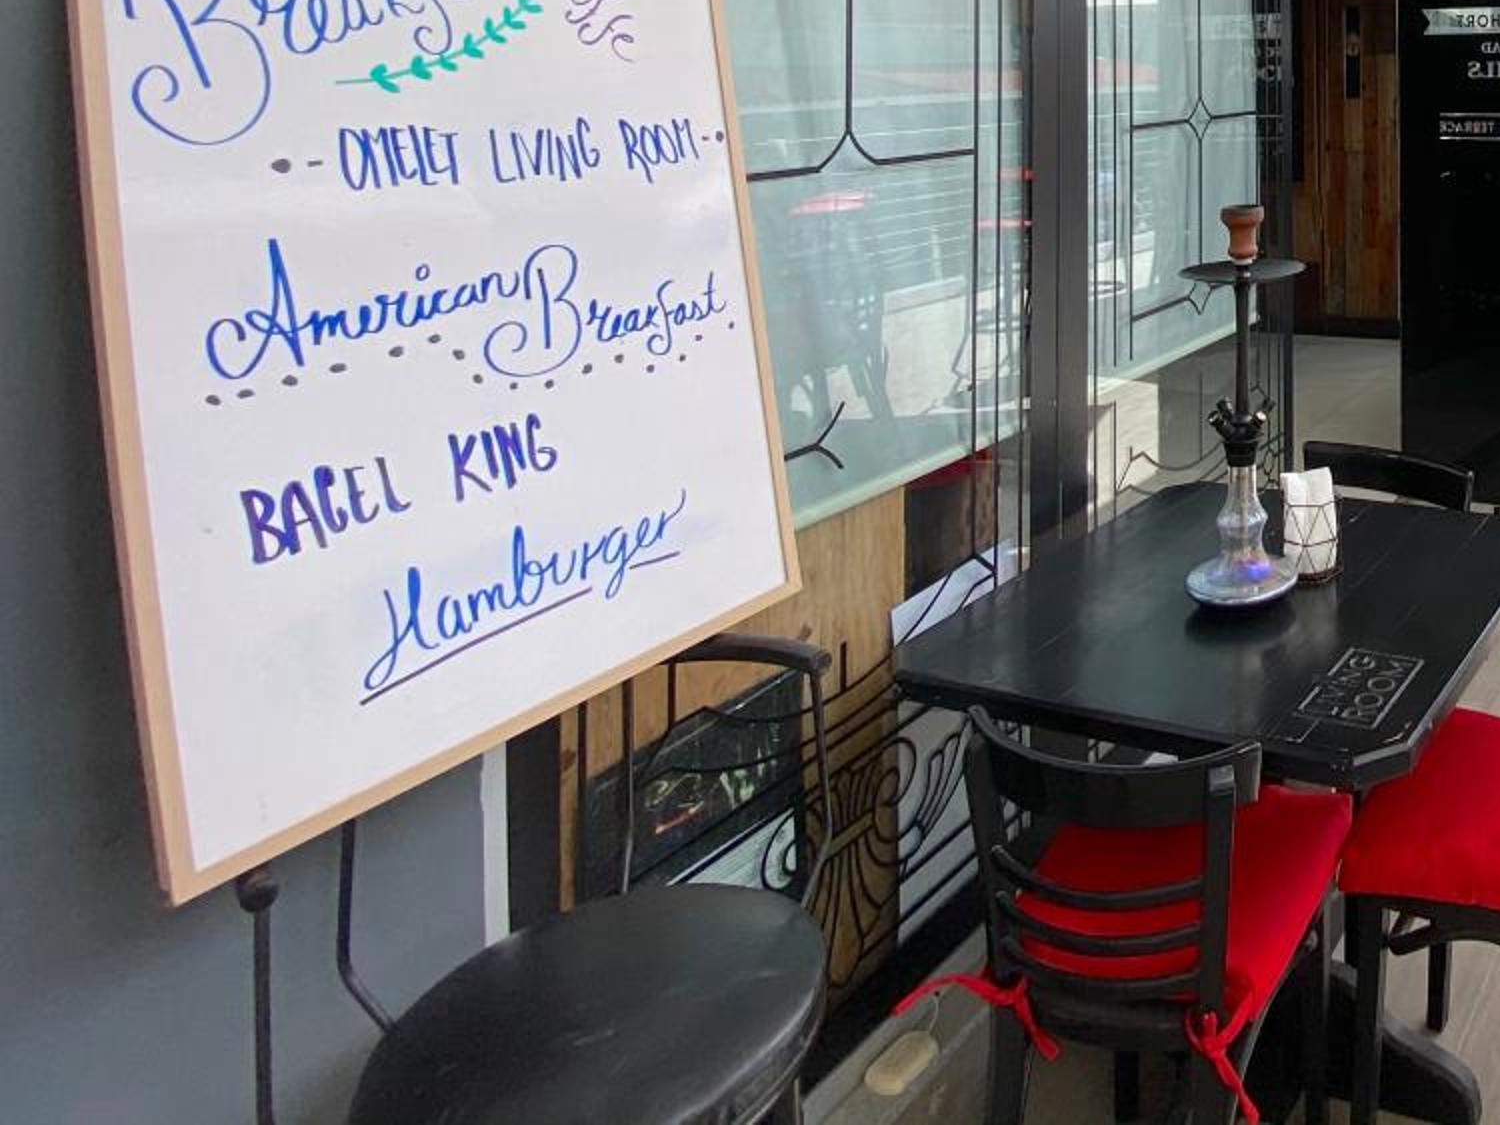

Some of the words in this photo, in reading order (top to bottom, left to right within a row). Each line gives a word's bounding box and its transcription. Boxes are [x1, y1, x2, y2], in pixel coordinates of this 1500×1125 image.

[489, 117, 602, 185] LIVING
[617, 117, 701, 184] ROOM
[206, 238, 521, 380] American
[483, 244, 727, 378] Breakfast
[447, 413, 558, 503] KING
[363, 488, 687, 690] Hamburger
[1341, 660, 1415, 722] ROOM
